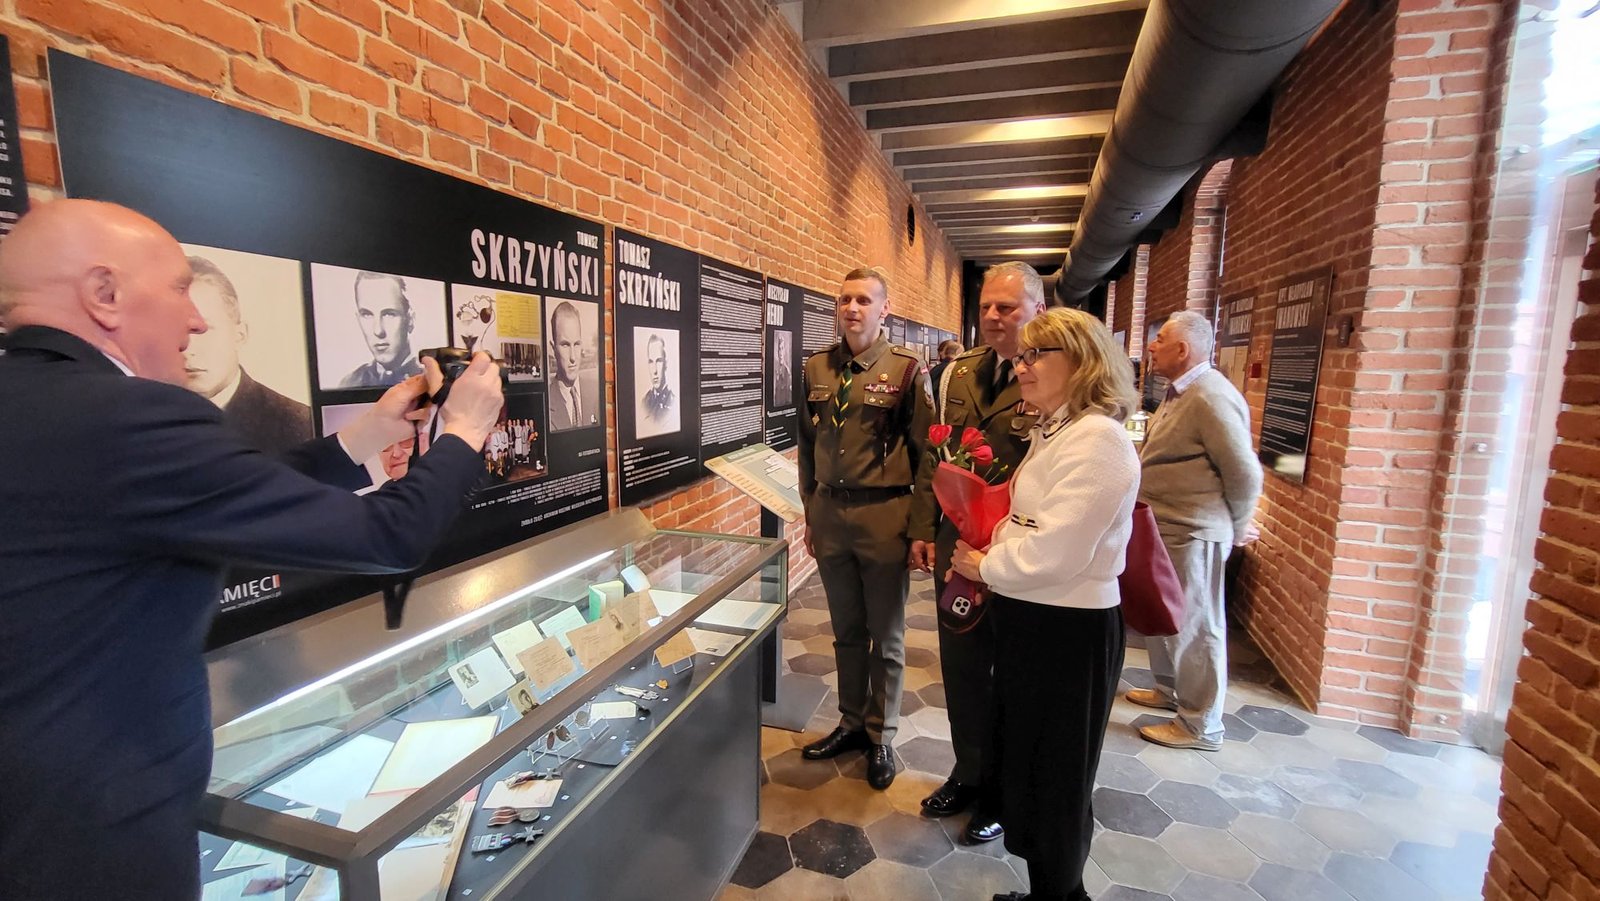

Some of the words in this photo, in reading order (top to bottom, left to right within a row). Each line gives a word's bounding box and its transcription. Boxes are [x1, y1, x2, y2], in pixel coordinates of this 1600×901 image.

[577, 231, 599, 249] TOMASZ
[619, 239, 651, 269] TOMASZ
[471, 229, 599, 296] SKRZYŃSKI
[619, 270, 680, 311] SKRZYŃSKI
[536, 460, 544, 470] 5.
[220, 574, 280, 604] MIĘCI
